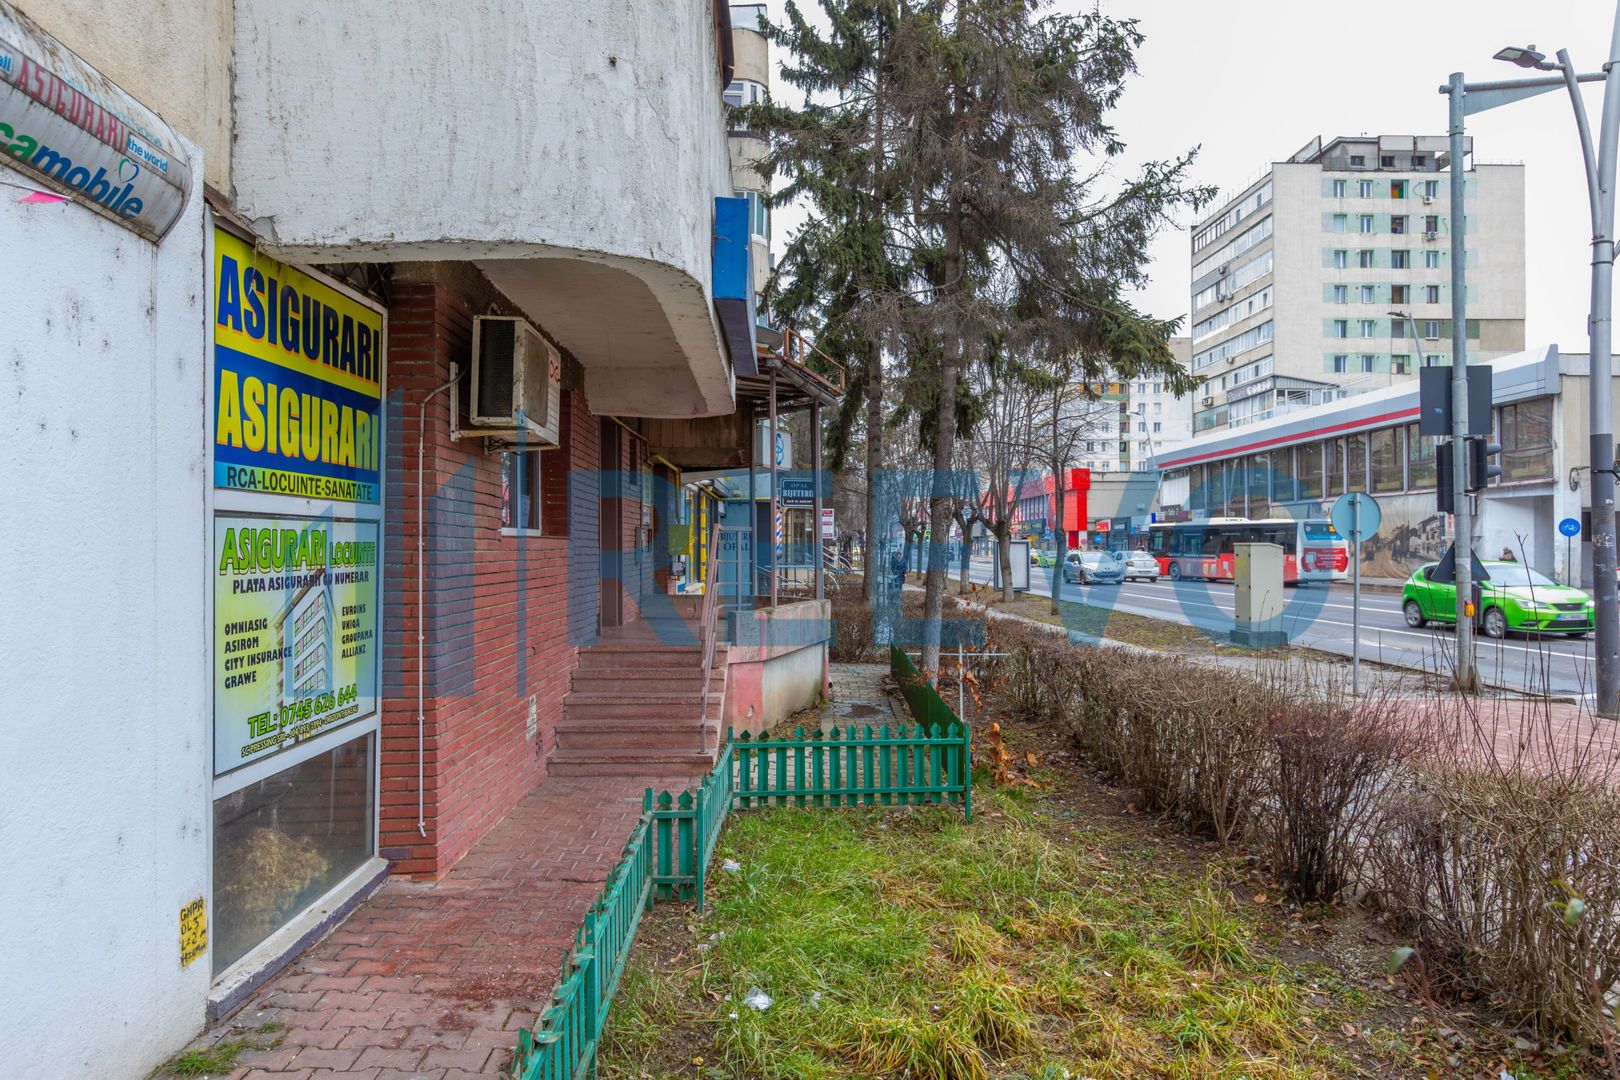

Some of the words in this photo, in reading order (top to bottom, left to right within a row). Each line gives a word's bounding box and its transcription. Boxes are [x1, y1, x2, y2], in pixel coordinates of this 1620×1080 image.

[17, 57, 126, 153] ASIGURARI
[128, 138, 143, 156] the
[144, 150, 168, 172] world
[217, 253, 380, 387] ASIGURARI
[216, 368, 379, 472] ASIGURARI
[227, 466, 373, 501] RCA-LOCUINTE-SANATATE
[220, 528, 327, 575] ASIGURARI
[329, 542, 375, 568] LOCUINTE
[233, 578, 266, 594] PLATA
[334, 571, 369, 584] NUMERAR
[342, 604, 366, 616] EUROINS
[225, 618, 268, 636] OMNIASIG
[342, 619, 360, 630] UNIQA
[225, 636, 259, 654] ASIROM
[342, 629, 373, 644] GROUPAMA
[225, 656, 245, 671] CITY
[247, 646, 292, 666] INSURANCE
[342, 644, 366, 659] ALLIANZ
[225, 671, 257, 689] GRAWE
[248, 711, 277, 738] TEL:
[280, 698, 312, 727] 0745
[314, 691, 335, 715] 626
[337, 683, 357, 706] 644
[250, 735, 278, 753] PRESSING
